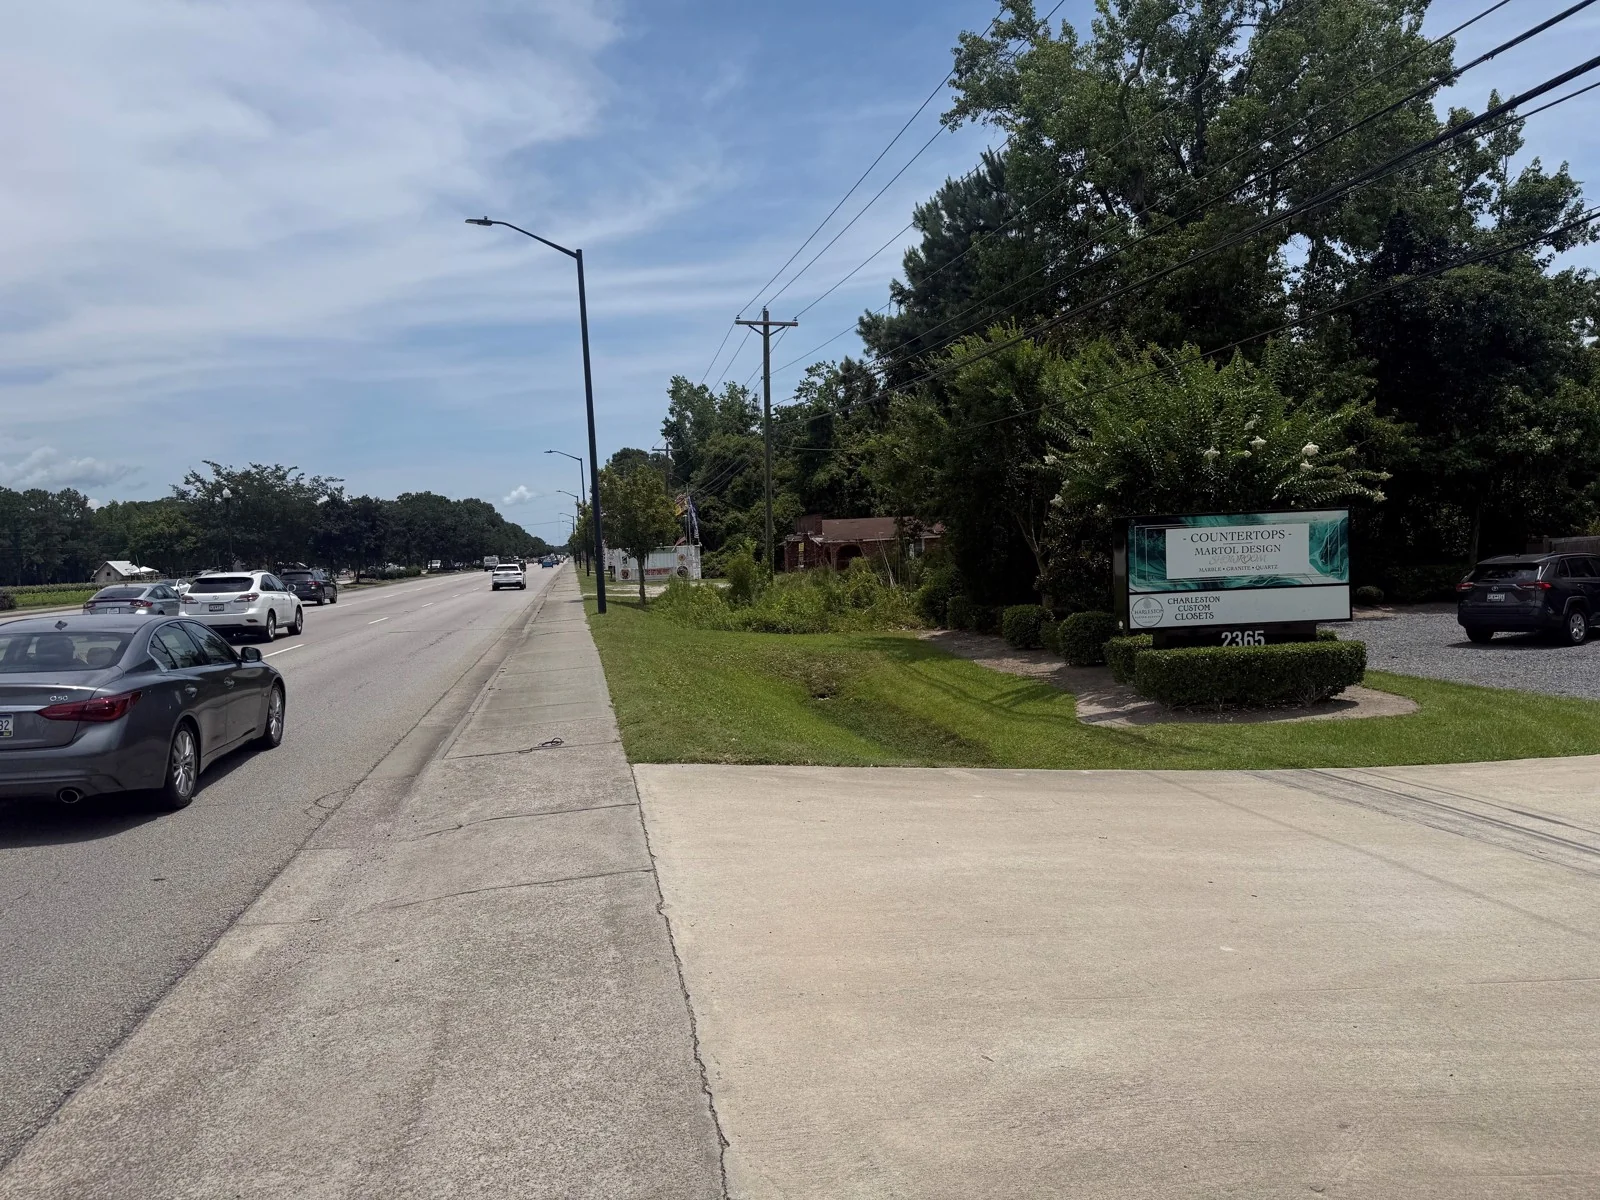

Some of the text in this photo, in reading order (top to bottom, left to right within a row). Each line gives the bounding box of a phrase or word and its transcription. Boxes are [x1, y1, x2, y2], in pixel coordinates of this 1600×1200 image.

[1190, 529, 1286, 543] COUNTERTOPS
[1194, 544, 1281, 556] MARTOL DESIGN
[1167, 596, 1221, 605] CHARLESTON
[1177, 604, 1210, 612] CUSTOM
[1174, 612, 1214, 621] CLOSETS
[1221, 630, 1265, 647] 2365
